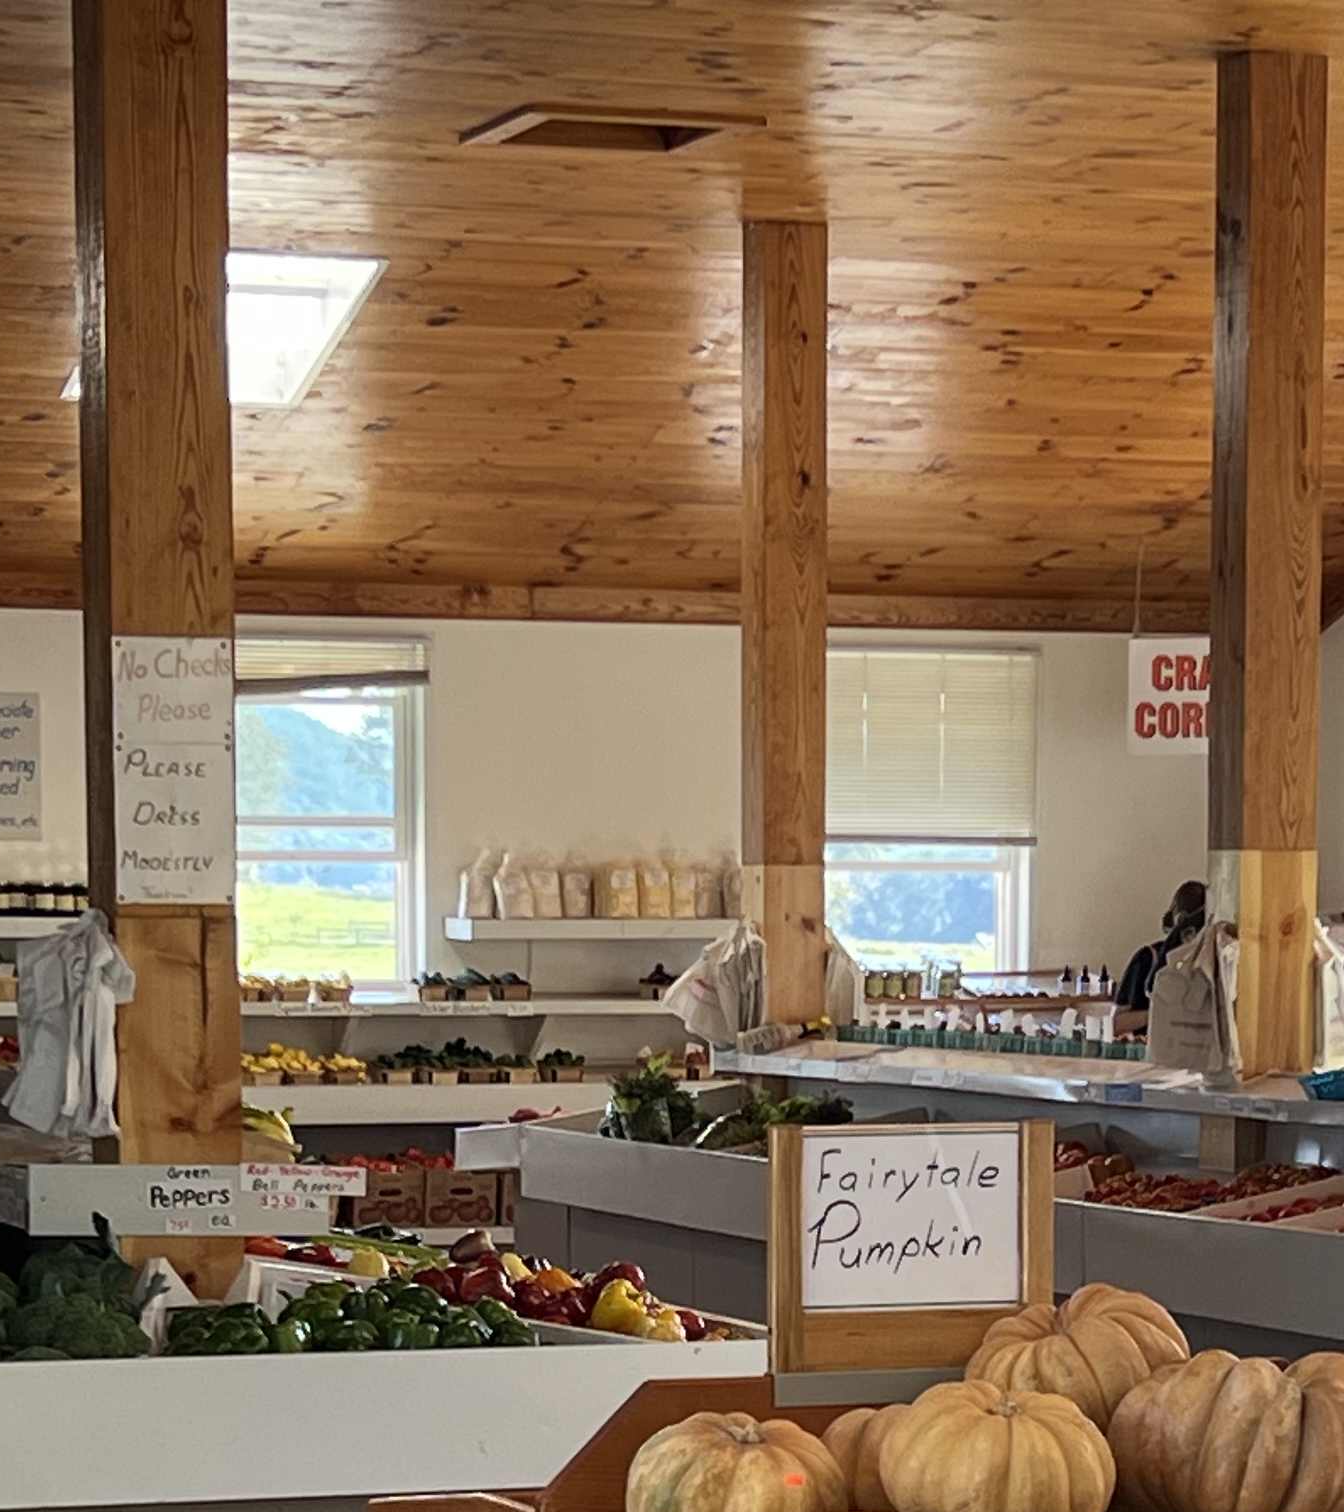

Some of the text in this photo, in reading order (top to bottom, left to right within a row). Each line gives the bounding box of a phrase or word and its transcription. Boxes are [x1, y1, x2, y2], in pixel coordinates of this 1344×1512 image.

[117, 647, 231, 682] No Checks
[137, 693, 212, 723] Please
[1134, 701, 1210, 739] COR
[166, 1166, 211, 1180] Green
[252, 1178, 345, 1193] Bell Peppers
[817, 1148, 999, 1203] Fairytale
[807, 1199, 982, 1274] Pumpkin
